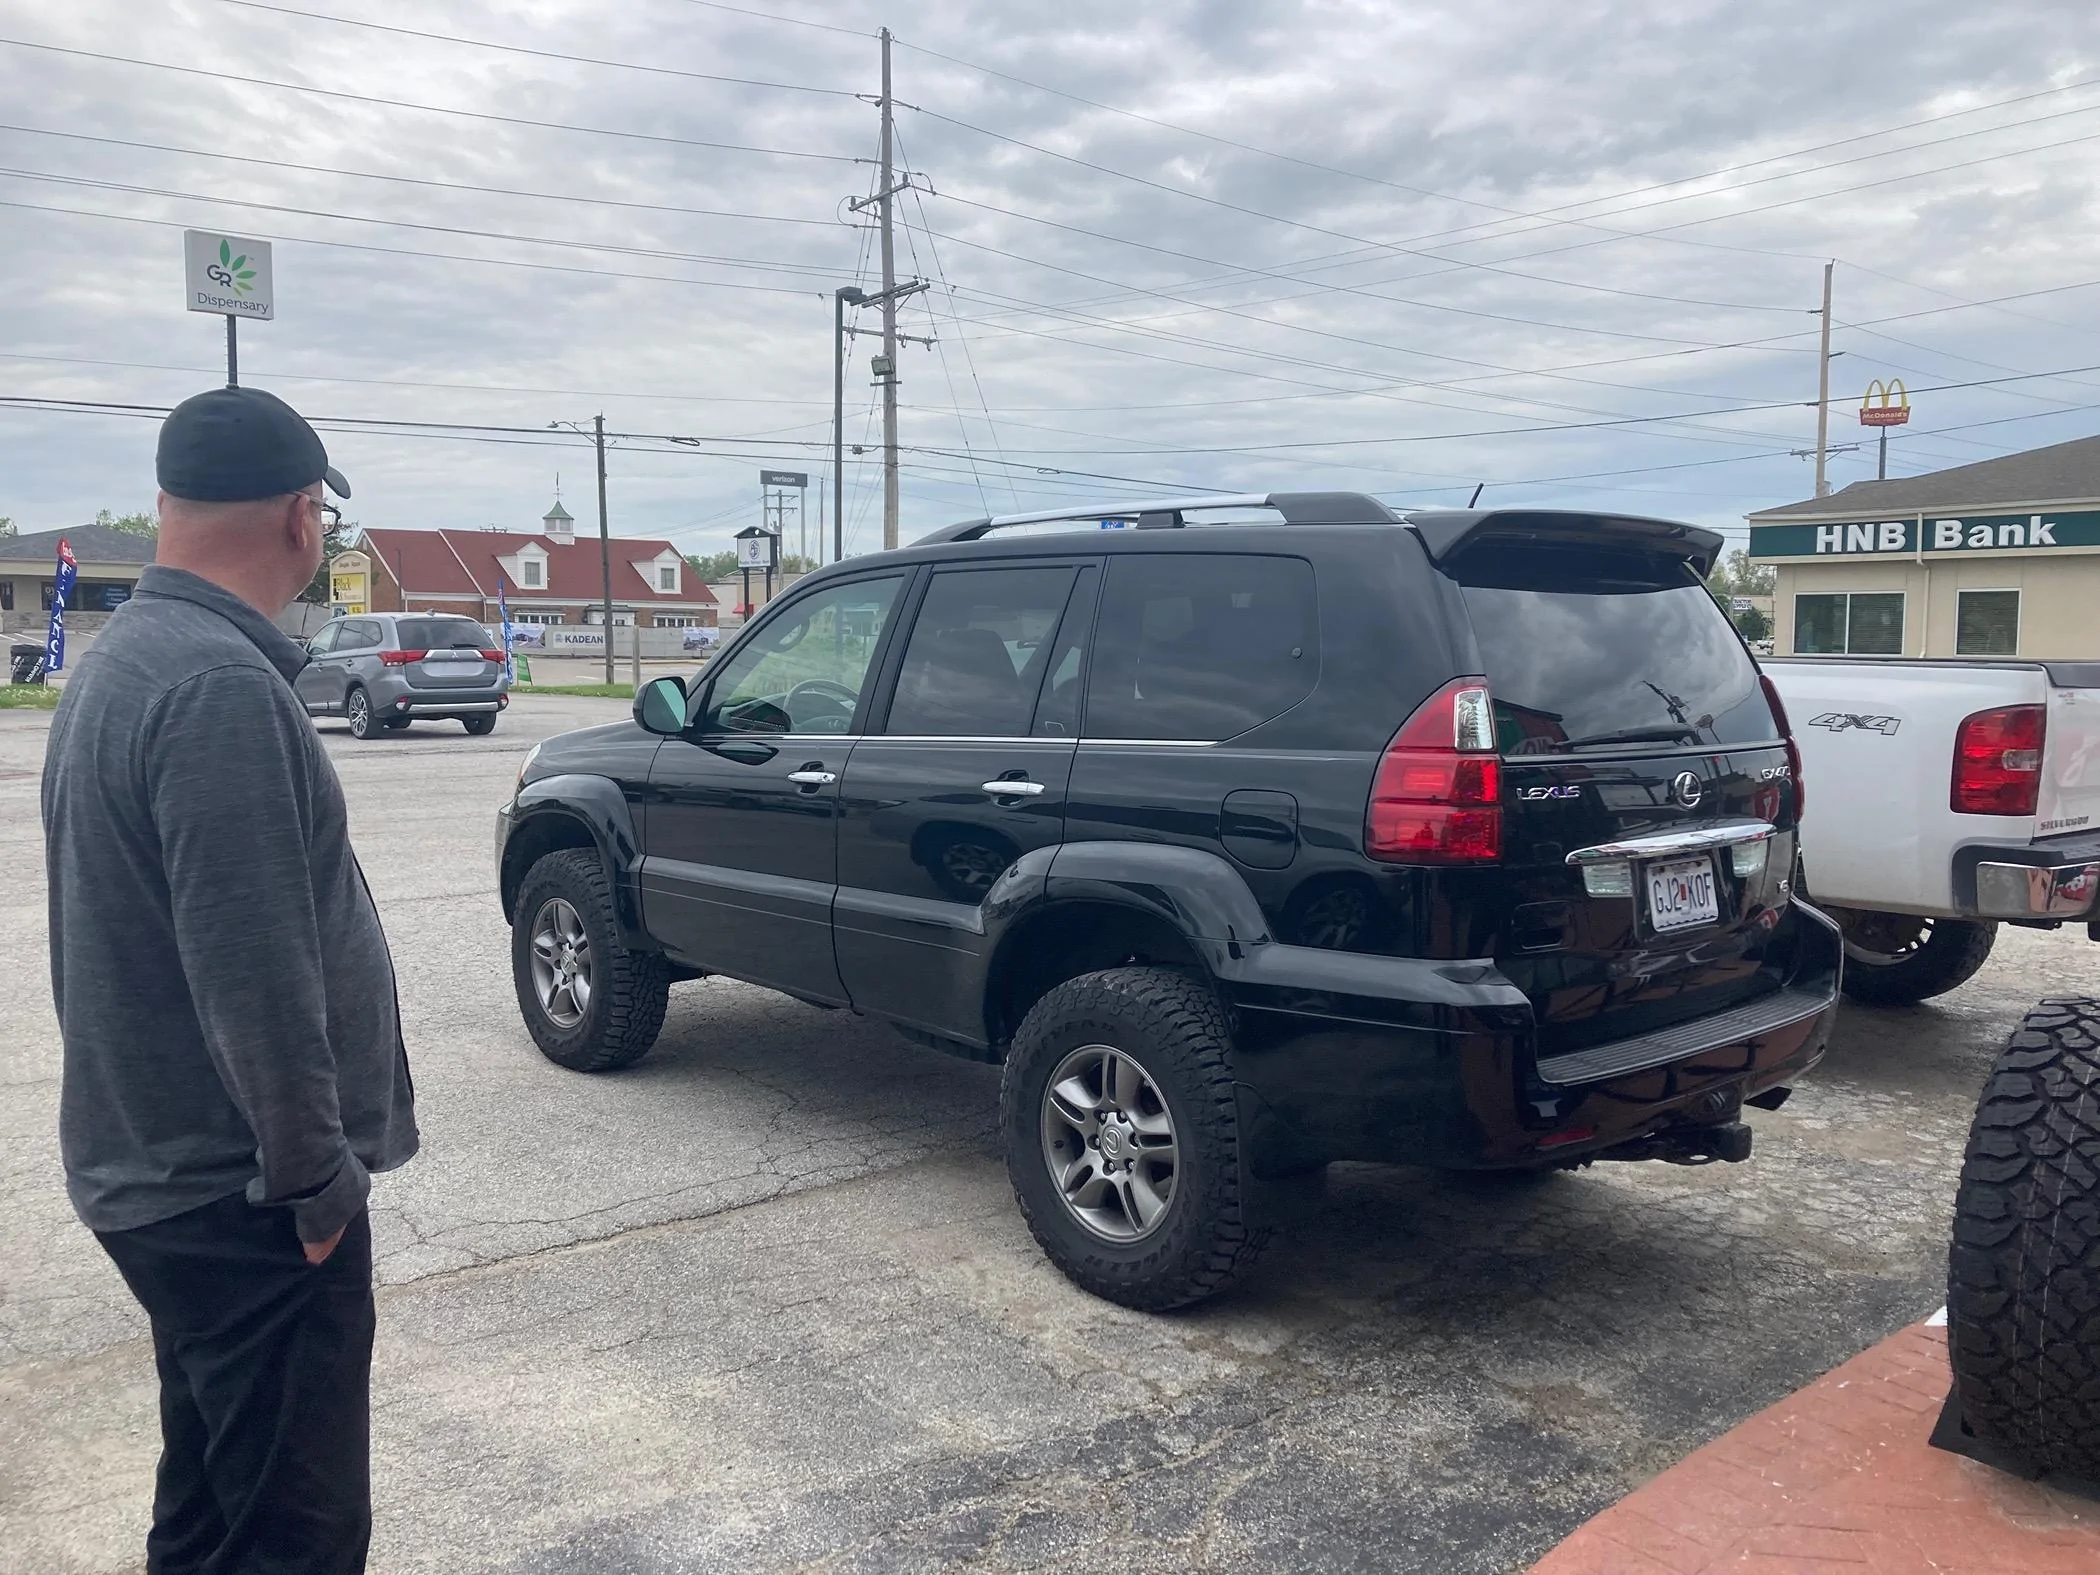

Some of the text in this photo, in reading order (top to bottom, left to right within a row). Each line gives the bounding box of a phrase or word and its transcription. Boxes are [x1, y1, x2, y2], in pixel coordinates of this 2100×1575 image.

[197, 292, 269, 314] Dispensary
[1862, 411, 1908, 420] McDonald's
[772, 475, 796, 483] verizon
[1816, 516, 2057, 554] HNB Bank
[565, 632, 604, 644] KADEAN
[1515, 785, 1581, 800] LEXUS
